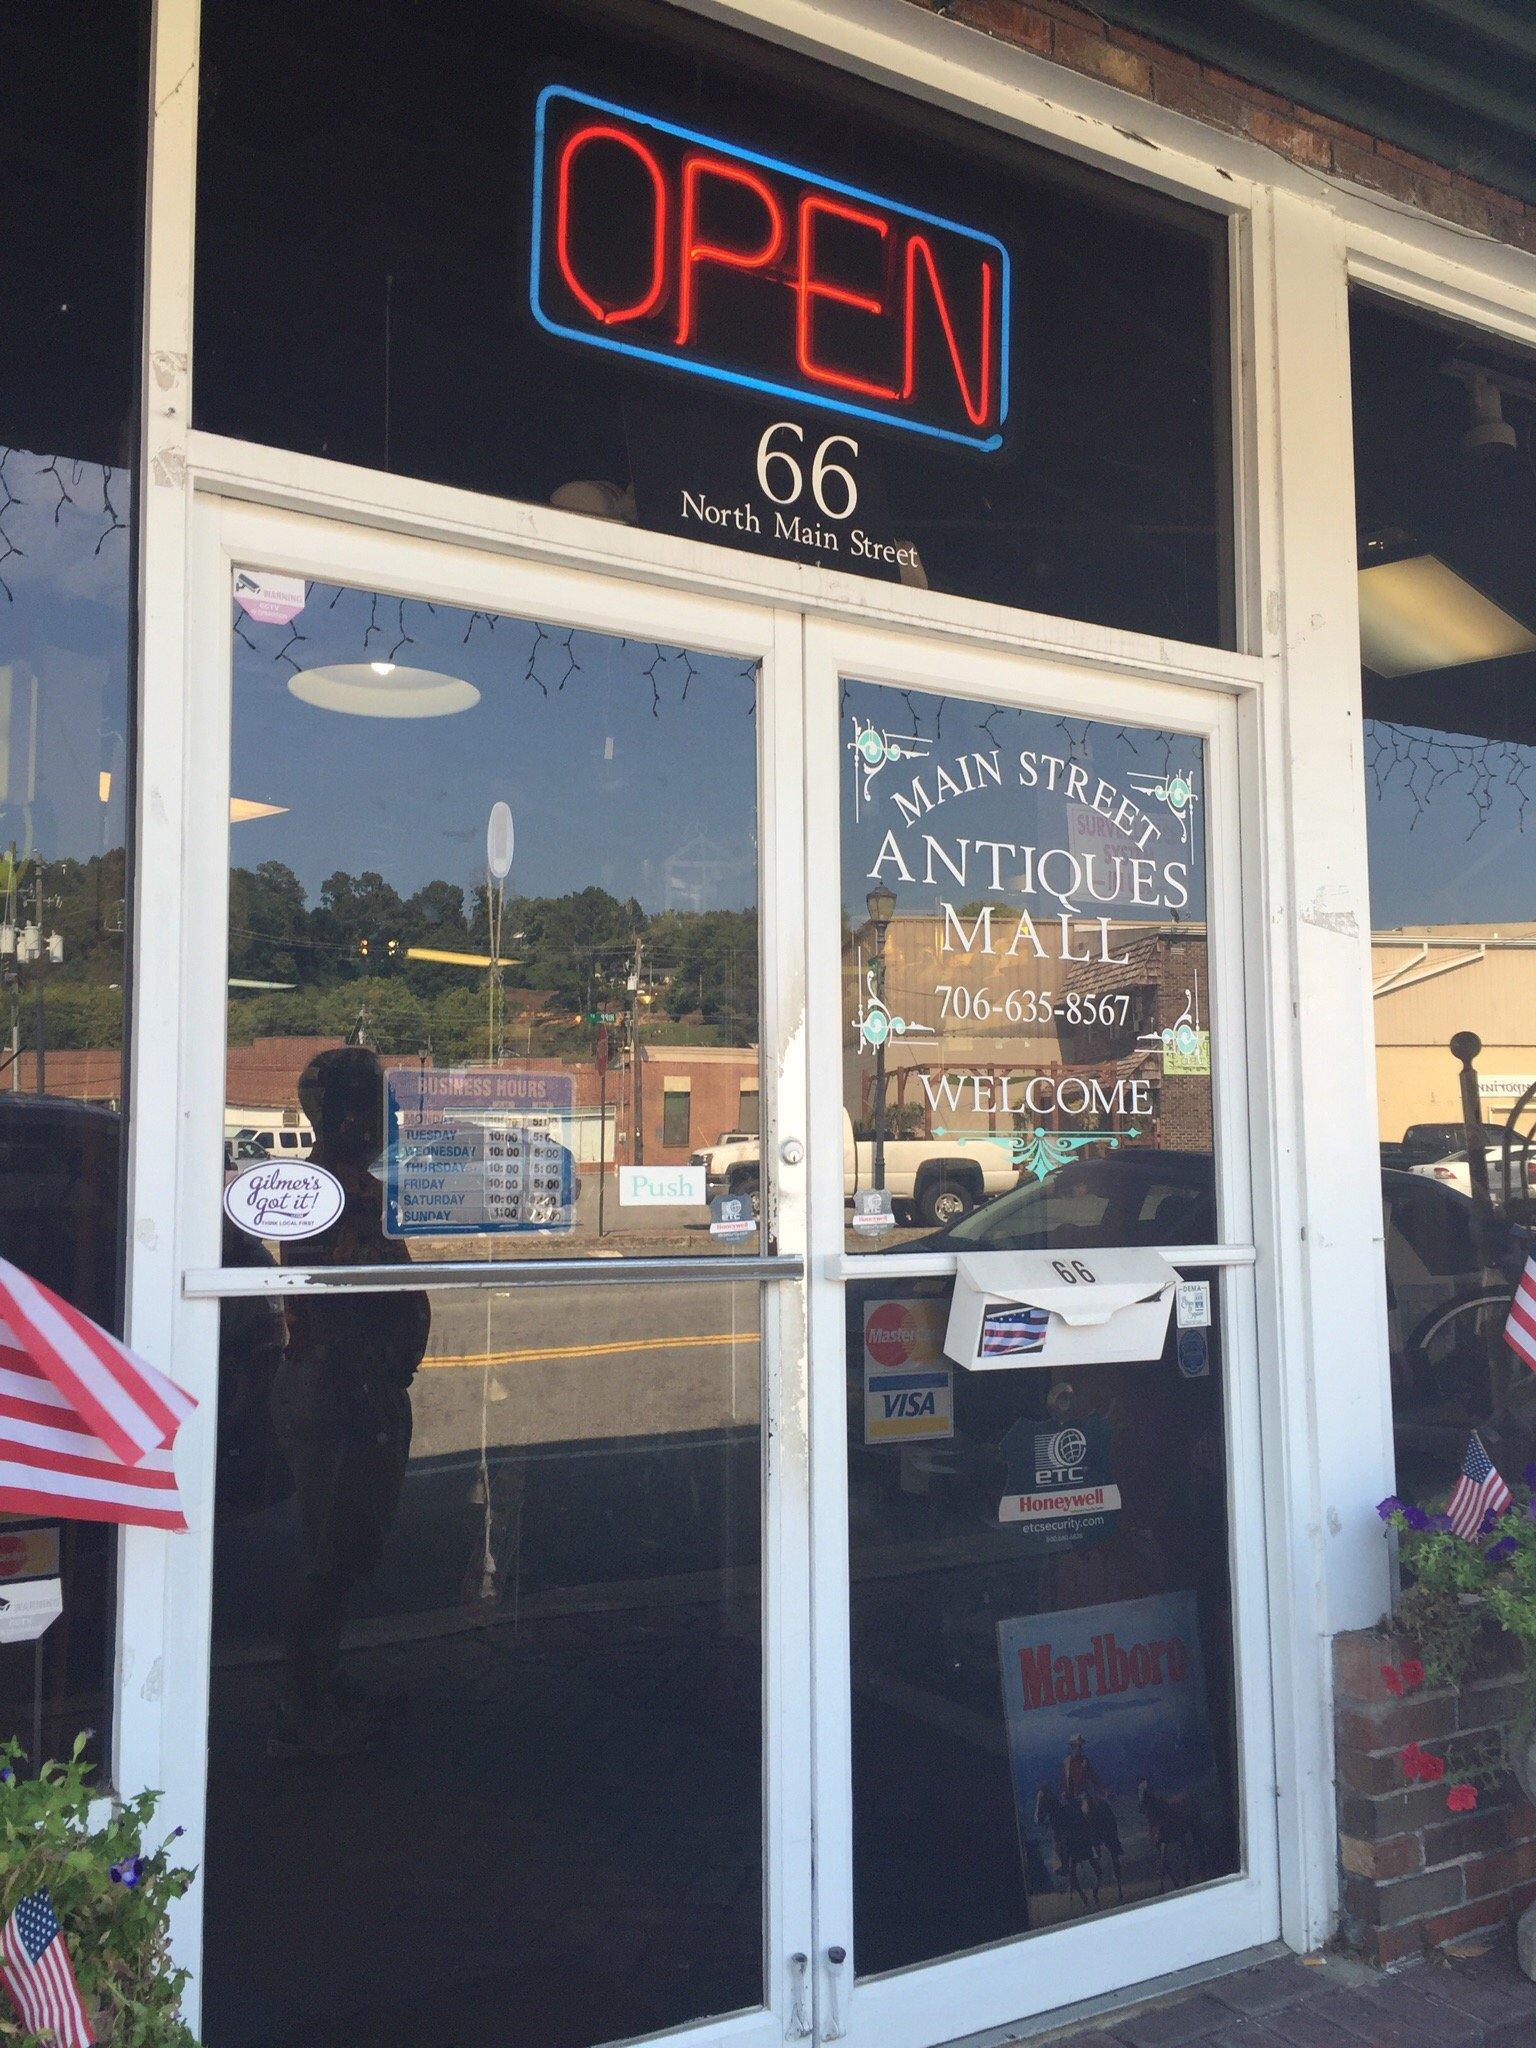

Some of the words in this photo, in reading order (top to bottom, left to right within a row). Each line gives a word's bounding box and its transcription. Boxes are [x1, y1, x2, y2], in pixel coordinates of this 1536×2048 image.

[556, 125, 993, 426] OPEN
[756, 421, 859, 519] 66
[680, 490, 762, 535] North
[773, 511, 840, 552] Main
[850, 529, 919, 568] Street
[890, 749, 1003, 829] MAIN
[1018, 751, 1162, 852] STREET
[866, 829, 1189, 913] ANTIQUES
[940, 902, 1130, 966] MALL
[934, 985, 1130, 1027] 706-635-8567
[418, 1077, 492, 1096] BUSINESS
[496, 1079, 548, 1098] HOURS
[918, 1074, 1154, 1116] WELCOME
[404, 1129, 457, 1141] TUESDAY
[404, 1145, 476, 1157] WEDNESDAY
[489, 1147, 520, 1158] 10:00
[404, 1162, 466, 1173] THURSDAY
[489, 1163, 519, 1174] 10:00
[246, 1168, 324, 1206] gilmer's
[403, 1179, 445, 1190] FRIDAY
[489, 1178, 518, 1190] 10:00
[534, 1178, 560, 1190] 5:00
[631, 1174, 695, 1198] Push
[253, 1192, 292, 1226] got
[293, 1191, 320, 1210] it!
[403, 1194, 465, 1205] SATURDAY
[489, 1194, 519, 1205] 10:00
[403, 1210, 451, 1222] SUNDAY
[494, 1207, 517, 1218] 1:00
[1052, 1260, 1096, 1284] 66
[883, 1391, 936, 1419] VISA
[1019, 1488, 1104, 1512] Honeywell
[1022, 1516, 1105, 1534] etcsecurity.com
[1018, 1633, 1190, 1712] Marlboro
